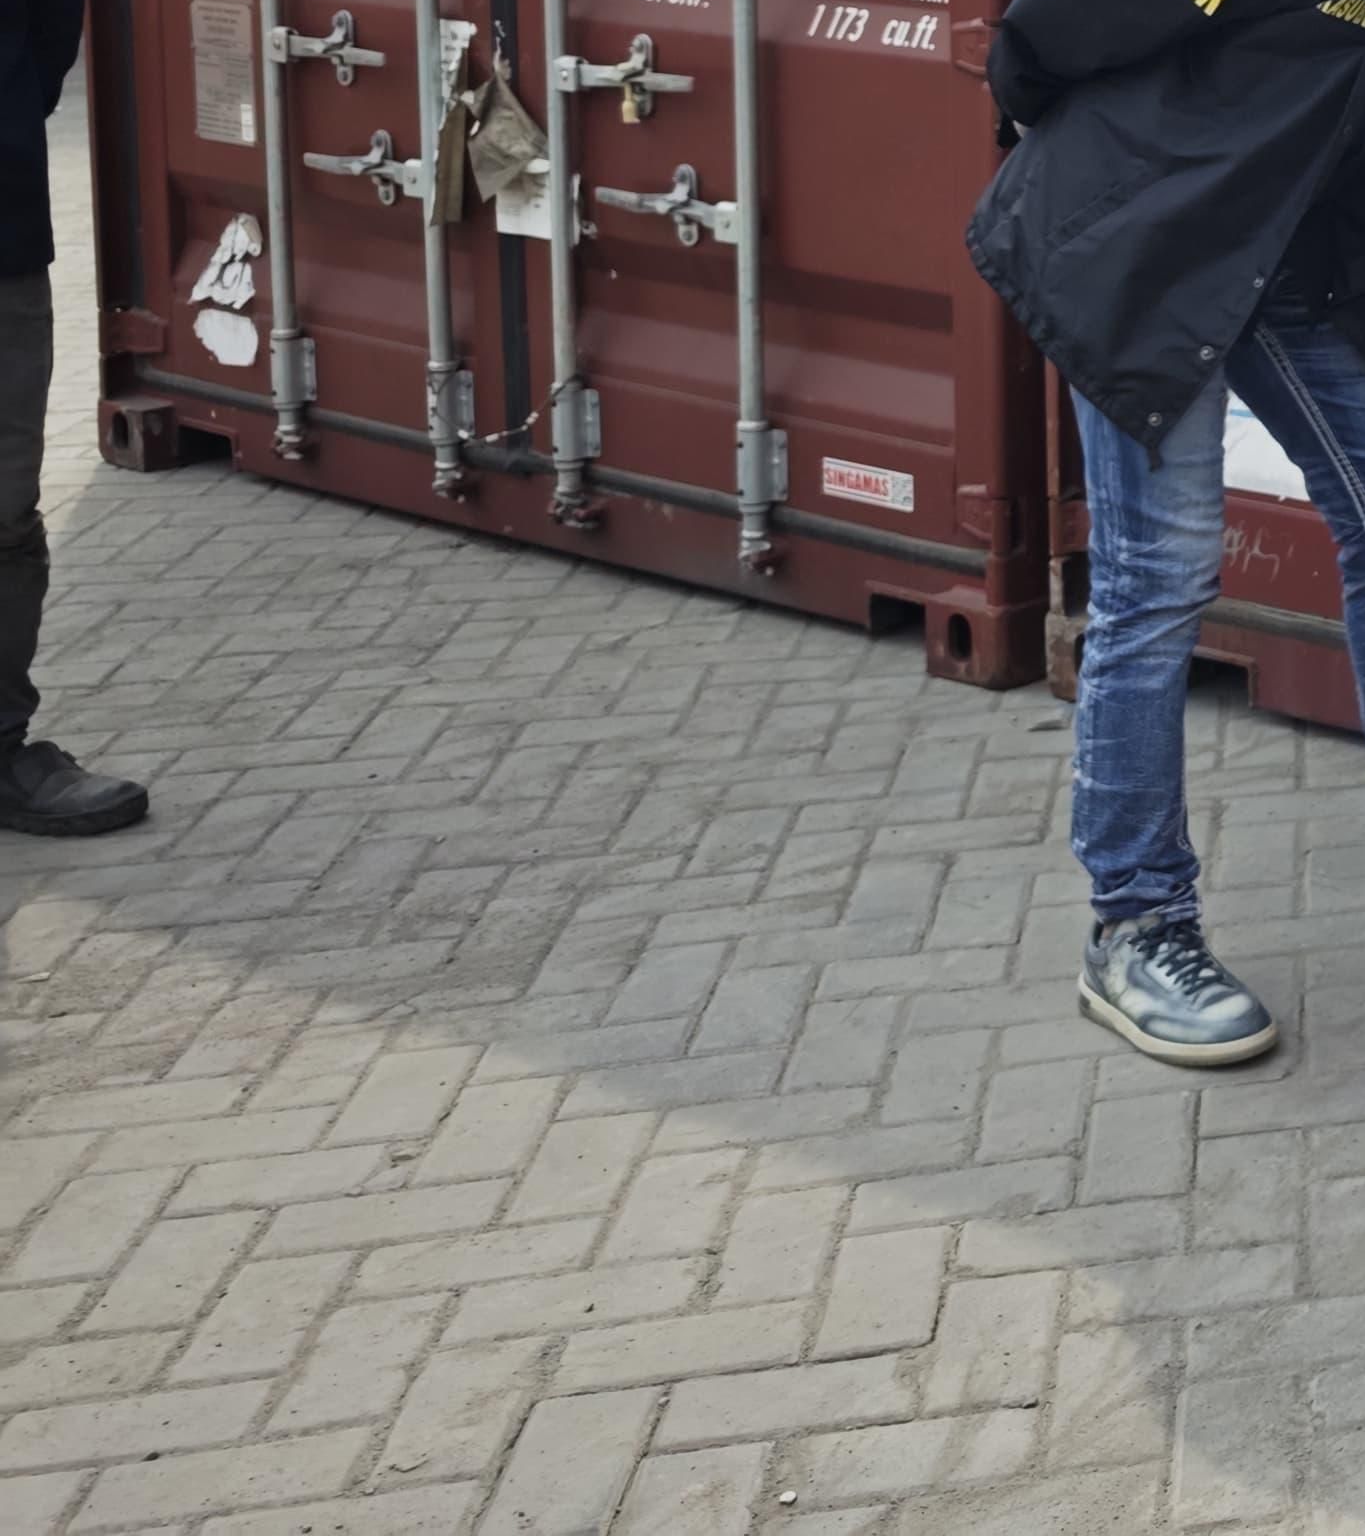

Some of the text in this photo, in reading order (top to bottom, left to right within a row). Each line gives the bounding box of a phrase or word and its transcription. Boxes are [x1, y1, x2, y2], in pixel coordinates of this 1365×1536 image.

[808, 4, 937, 51] 1 173 cu.ft.
[823, 467, 889, 497] SINGAMAS
